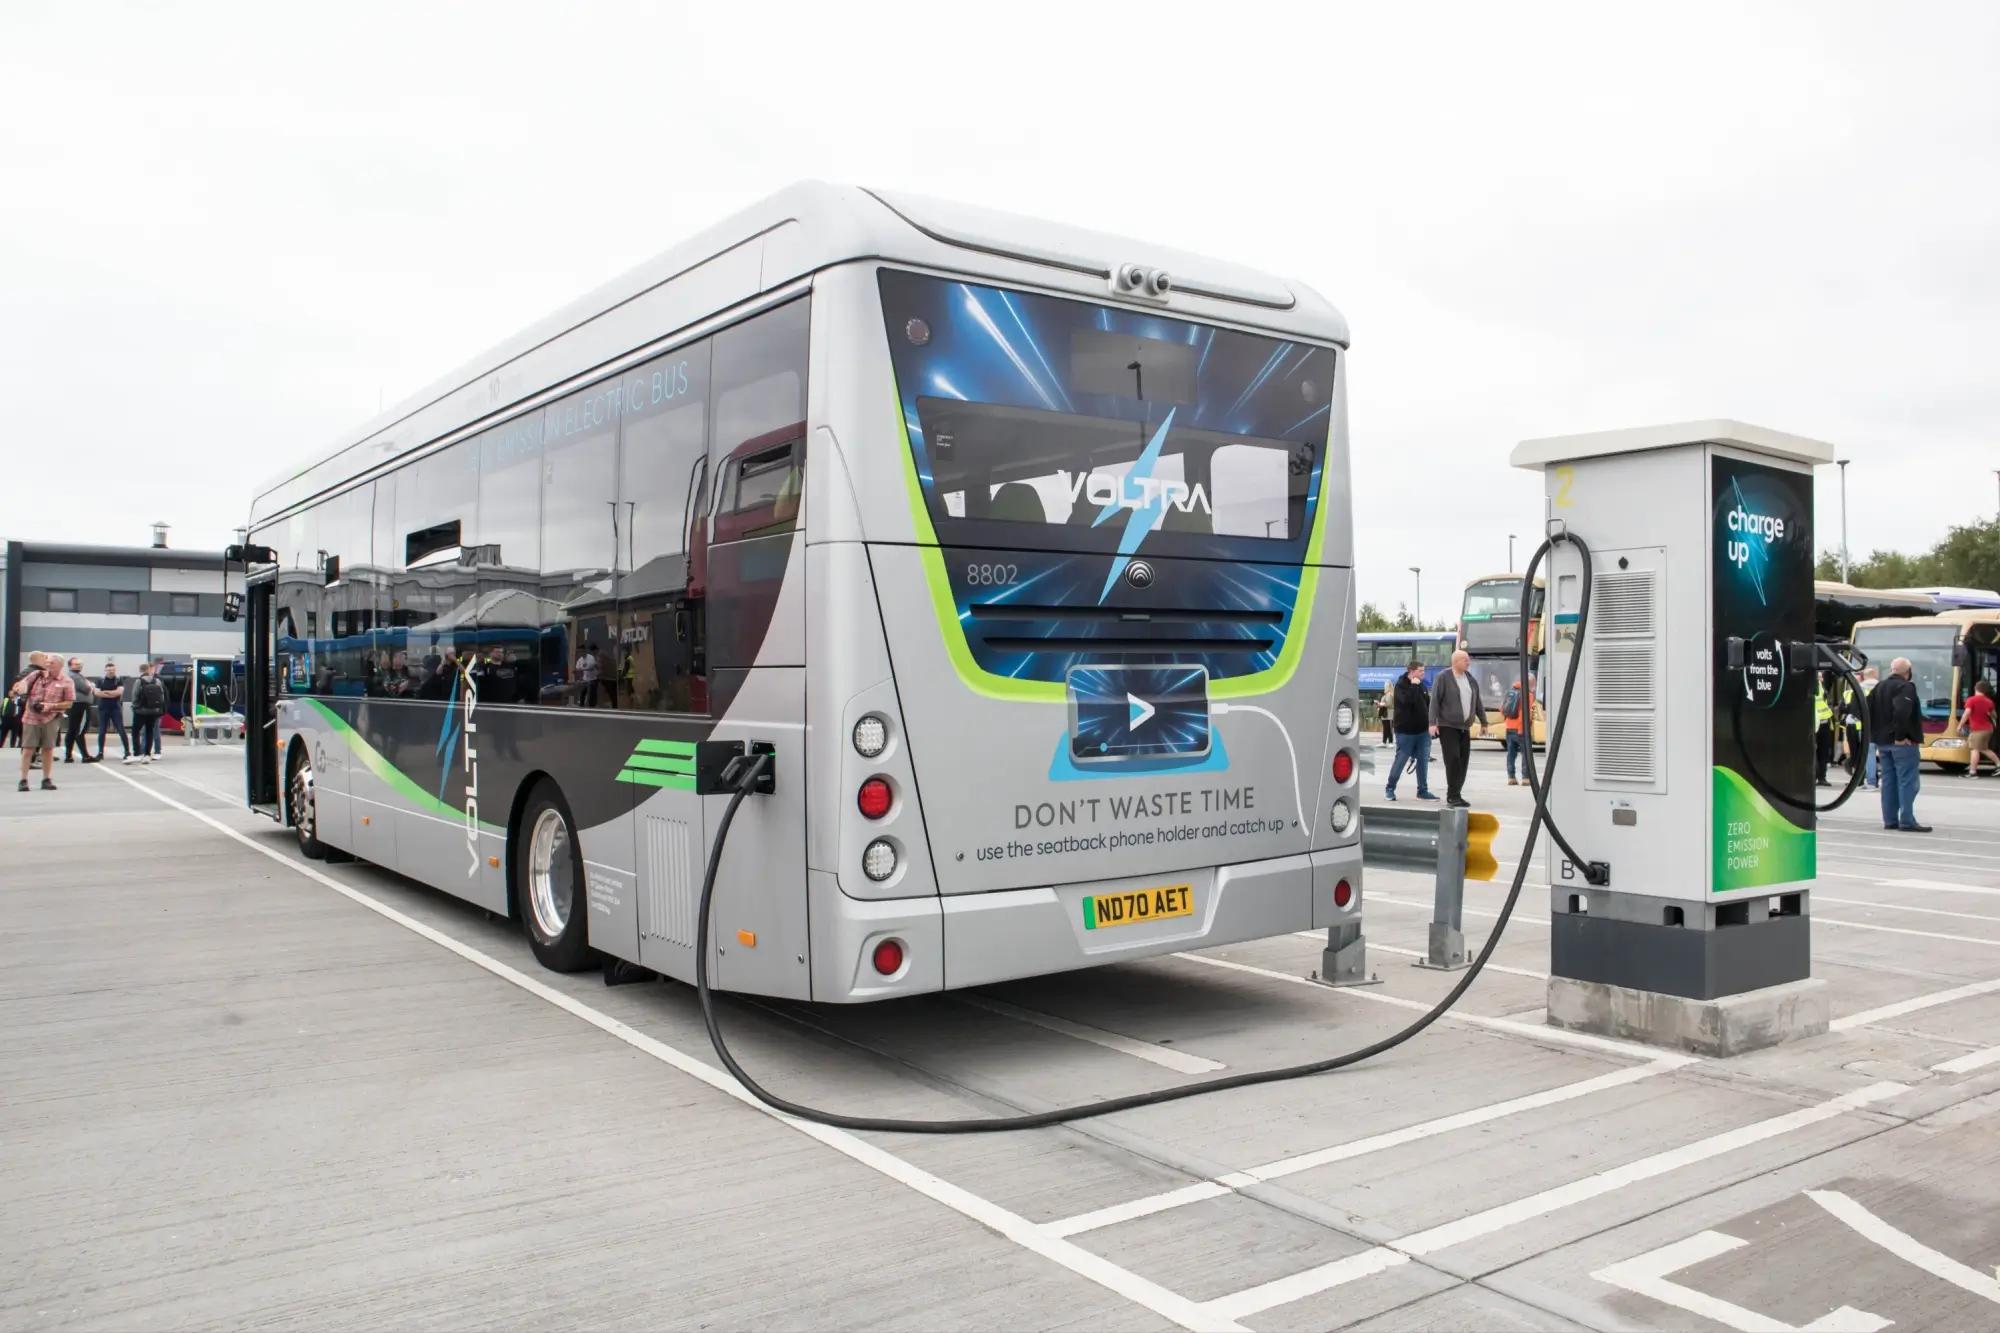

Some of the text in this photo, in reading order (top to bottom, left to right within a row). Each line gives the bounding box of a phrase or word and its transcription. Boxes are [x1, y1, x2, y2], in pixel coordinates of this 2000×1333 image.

[564, 380, 645, 436] ELECTRIC
[651, 361, 689, 405] BUS
[1065, 469, 1213, 515] VOLTRA
[1555, 465, 1575, 508] 2
[1728, 505, 1784, 542] charge
[1728, 541, 1749, 568] up
[967, 564, 1018, 585] 8802
[1756, 649, 1773, 661] volts
[1750, 664, 1778, 675] from the
[1757, 679, 1772, 691] blue
[464, 653, 480, 878] VOLTRA
[1109, 791, 1192, 821] WASTE
[1201, 787, 1255, 812] TIME
[977, 817, 1284, 861] use the seatback phone holder and catch up
[1727, 822, 1750, 836] ZERO
[1727, 838, 1769, 853] EMISSION
[1561, 860, 1575, 879] B
[1727, 856, 1759, 870] POWER
[1097, 887, 1188, 923] ND70 AET
